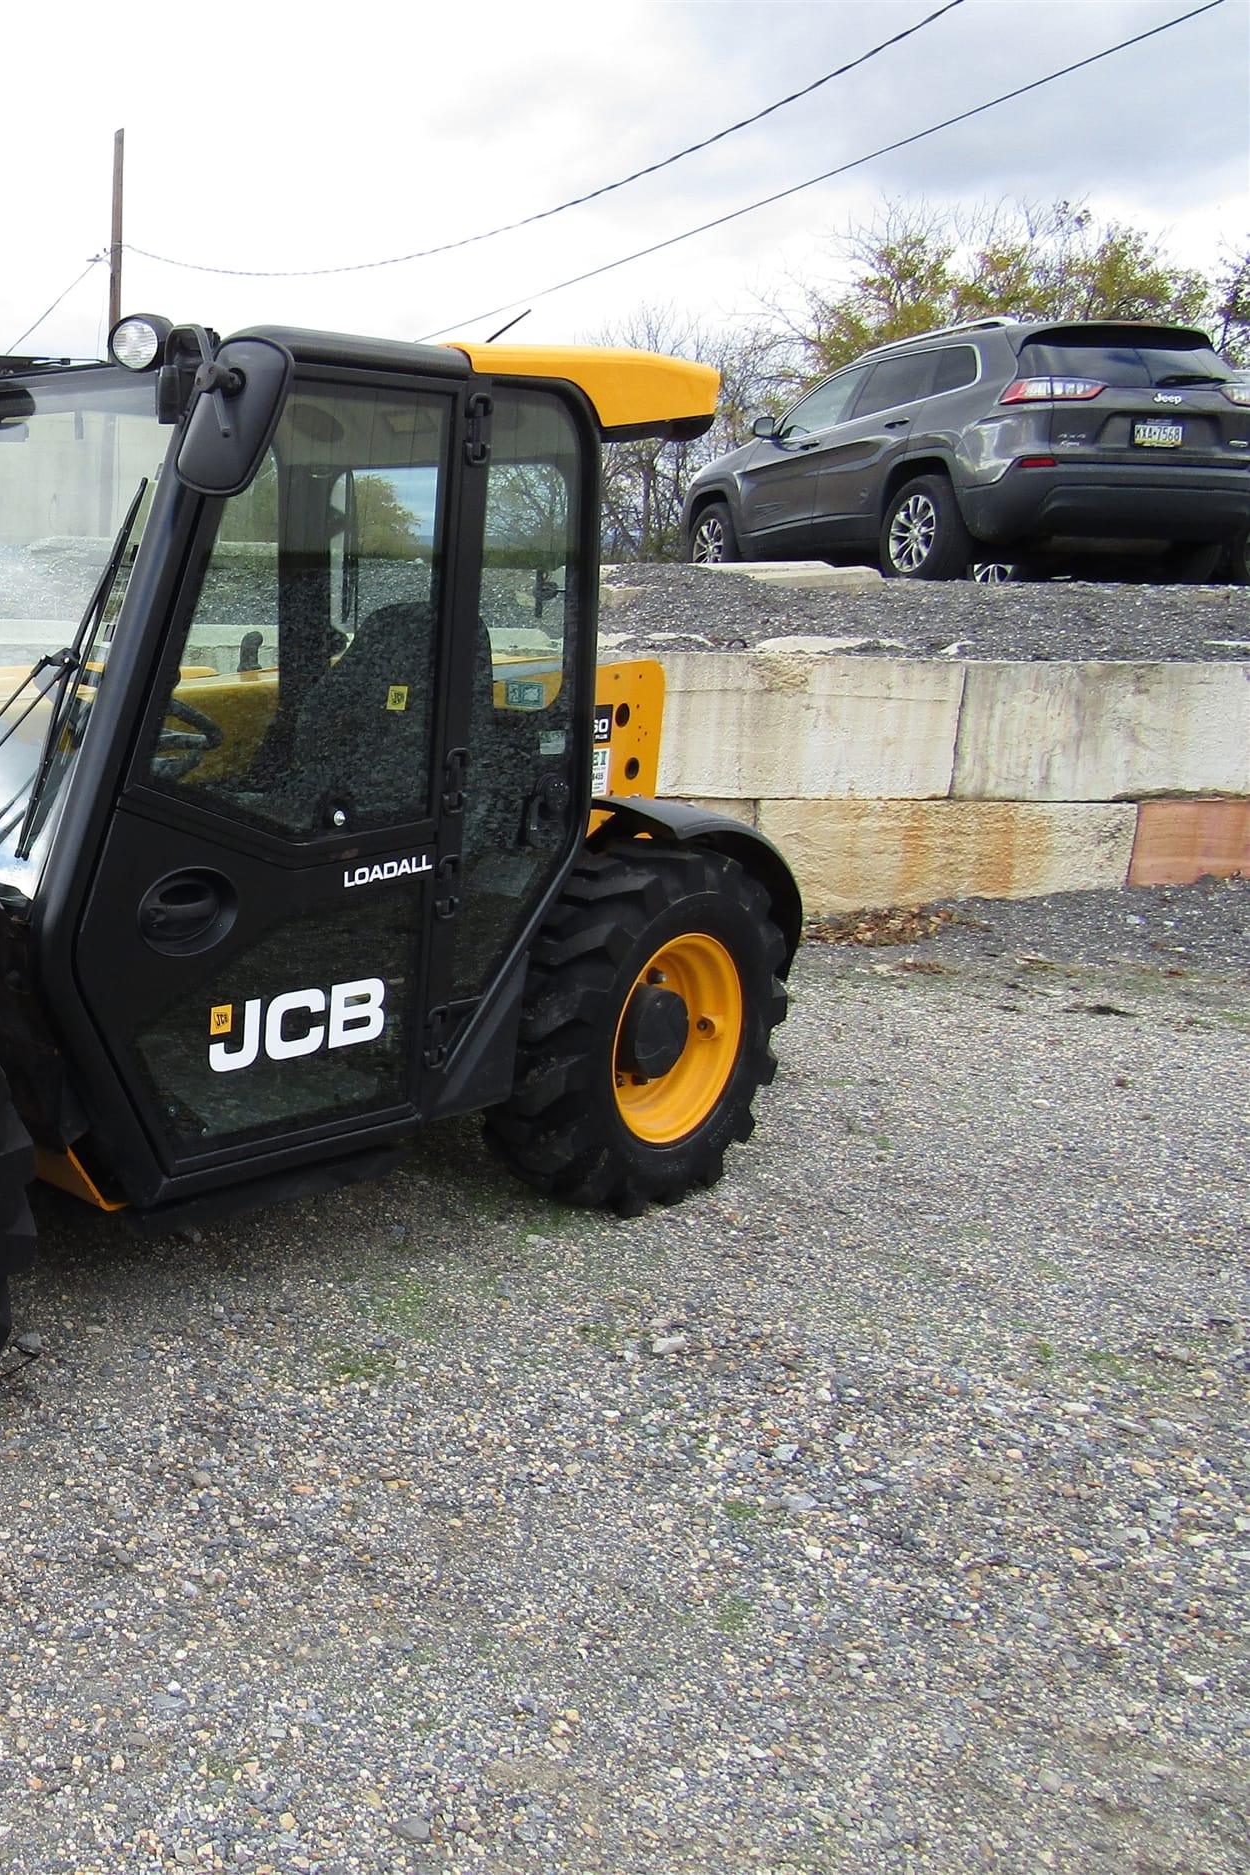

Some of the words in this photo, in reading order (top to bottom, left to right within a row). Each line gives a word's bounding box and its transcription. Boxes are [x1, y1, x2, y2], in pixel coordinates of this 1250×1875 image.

[1153, 392, 1182, 406] Jeep
[343, 854, 433, 888] LOADALL
[209, 977, 385, 1073] JCB
